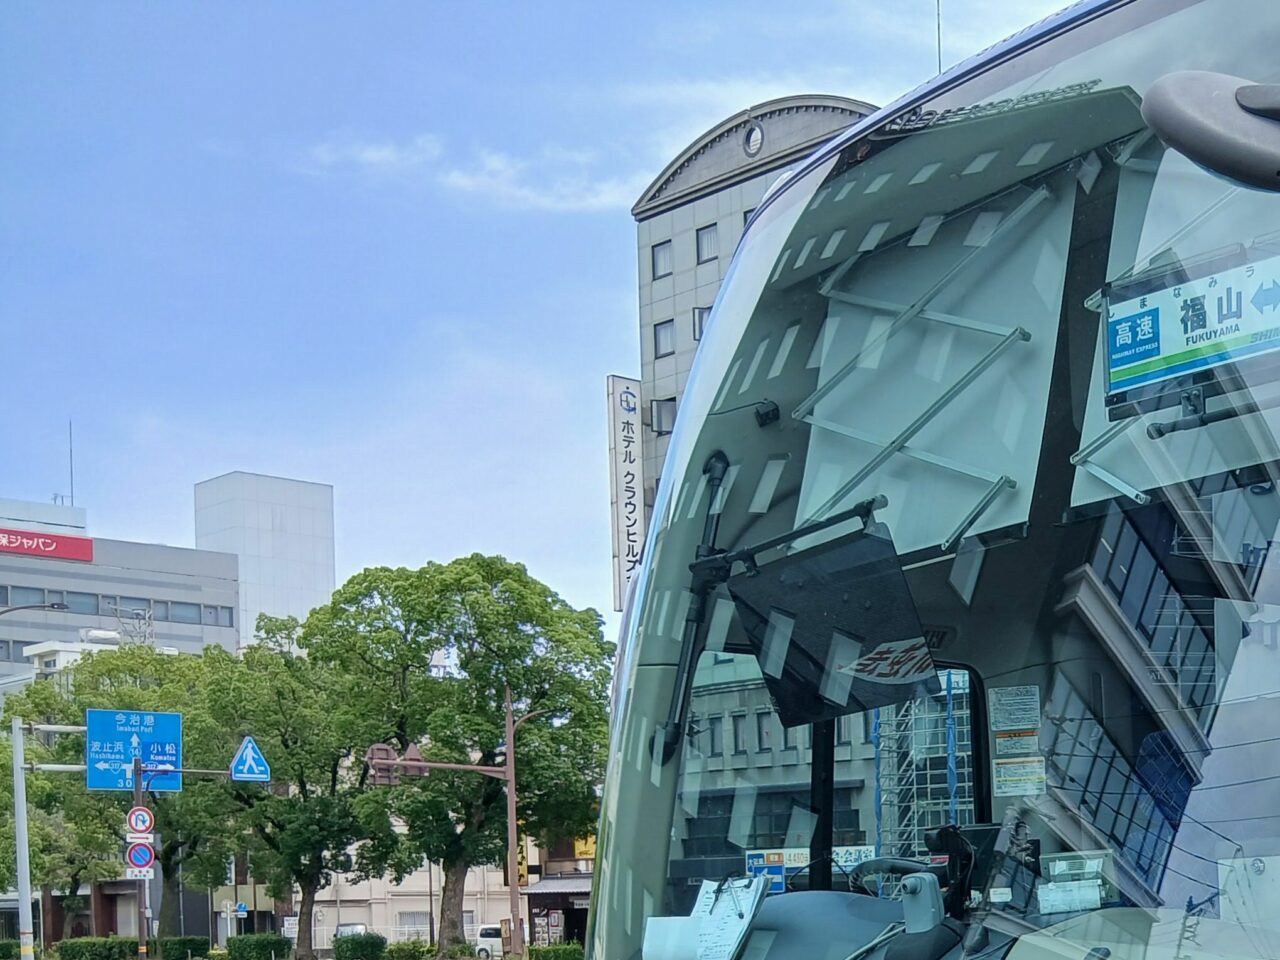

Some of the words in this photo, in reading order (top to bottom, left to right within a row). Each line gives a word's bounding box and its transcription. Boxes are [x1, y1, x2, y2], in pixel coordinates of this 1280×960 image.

[1179, 286, 1243, 335] 福山
[1115, 314, 1154, 348] 高速
[1185, 323, 1241, 347] FUKUYAMA
[1135, 342, 1159, 354] EXPRESS
[621, 420, 636, 465] ホテル
[115, 713, 155, 726] 今治港
[140, 725, 153, 733] Port
[90, 741, 124, 753] 波止浜
[150, 743, 176, 754] 小松
